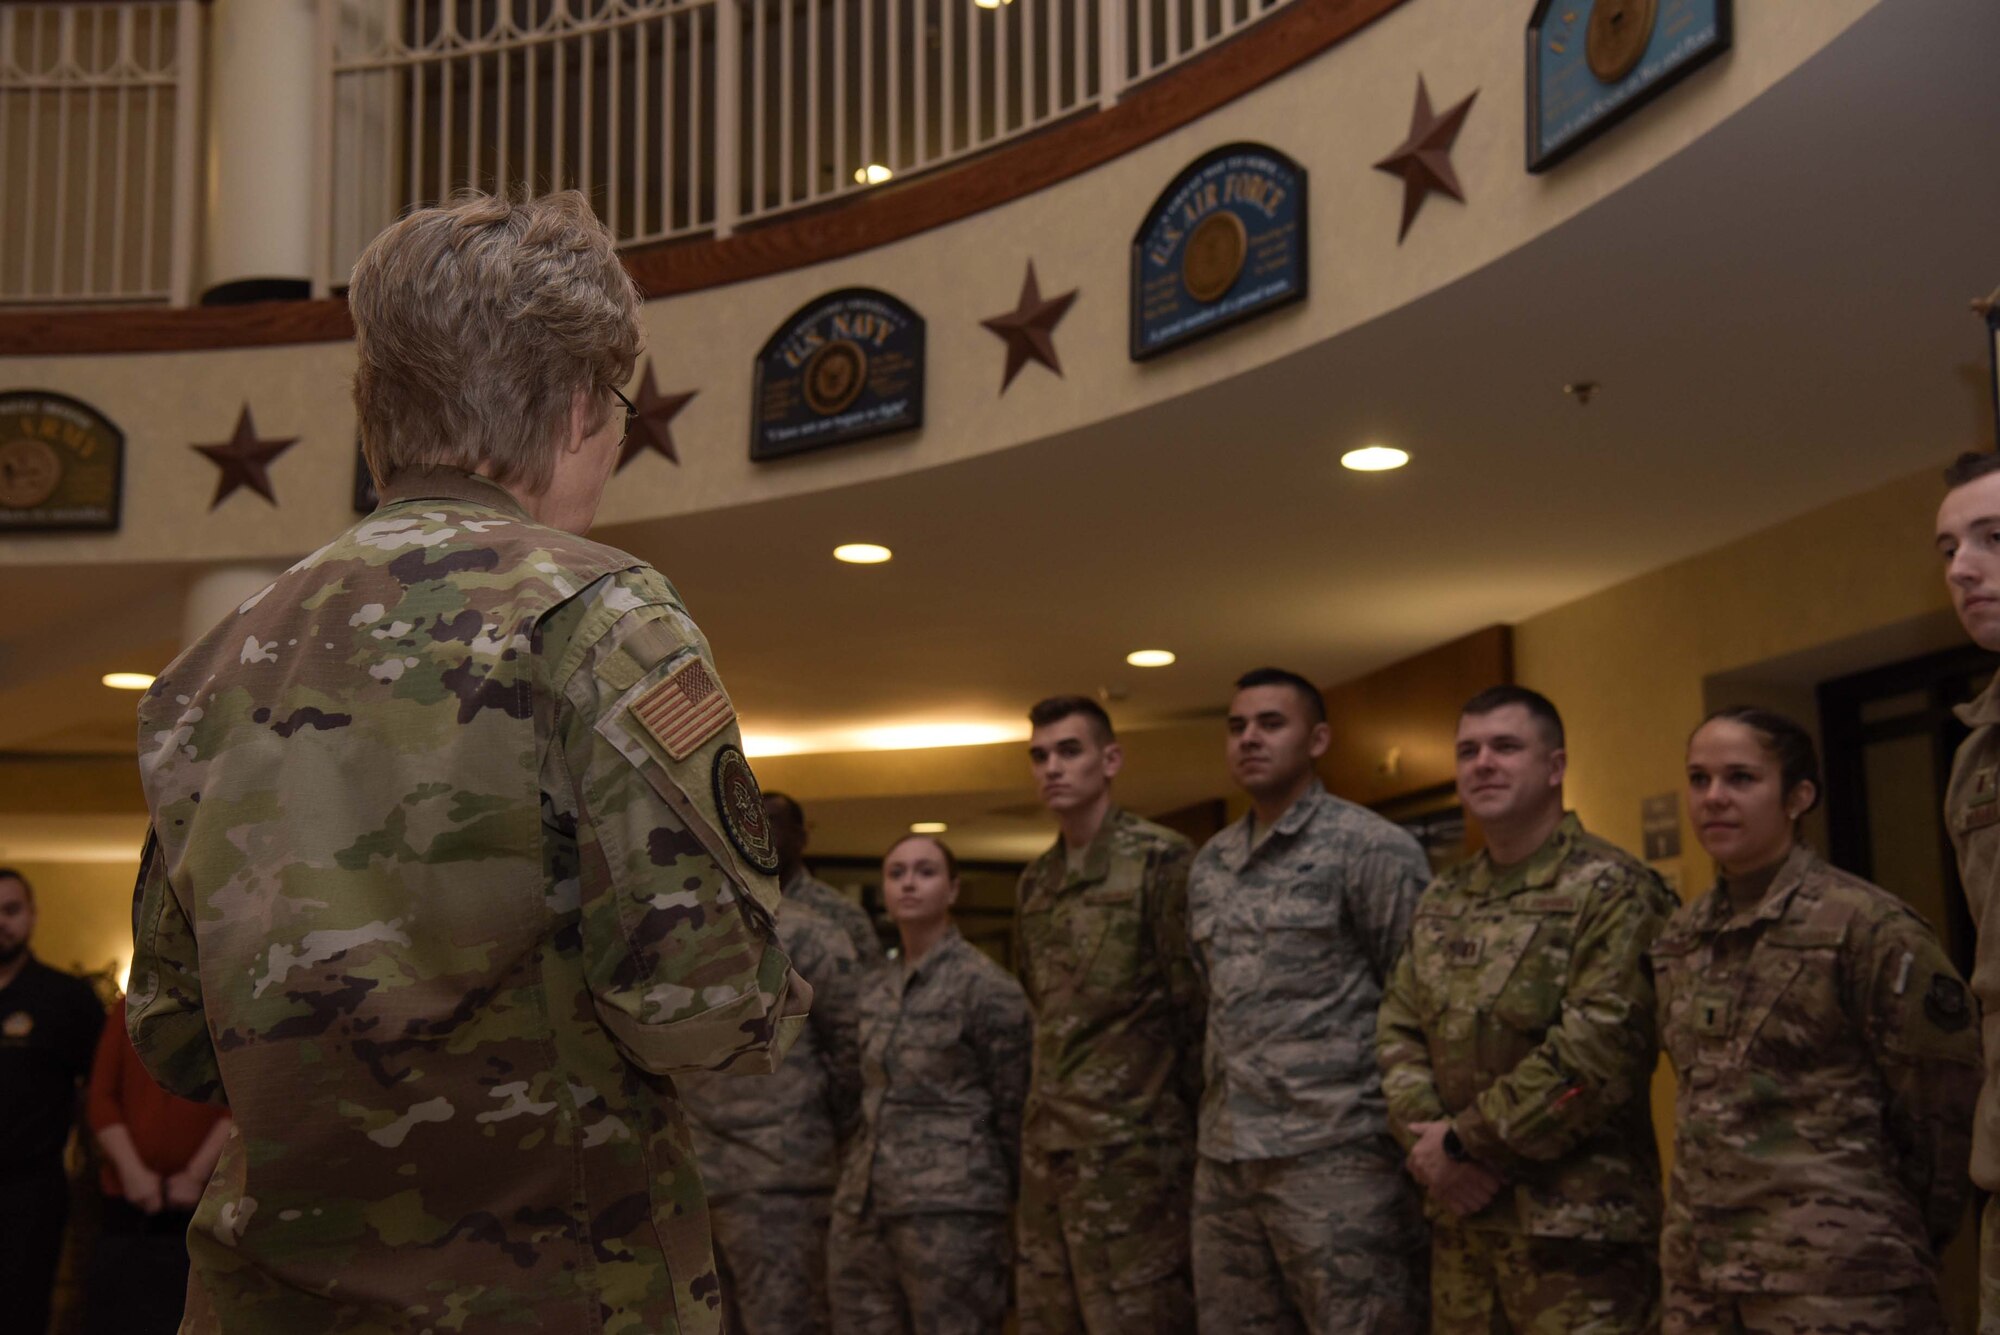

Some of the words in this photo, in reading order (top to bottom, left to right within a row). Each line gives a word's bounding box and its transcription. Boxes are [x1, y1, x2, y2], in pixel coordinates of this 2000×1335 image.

[1183, 182, 1219, 227] AIR
[1223, 172, 1287, 218] FORCE
[831, 312, 896, 347] NAVY
